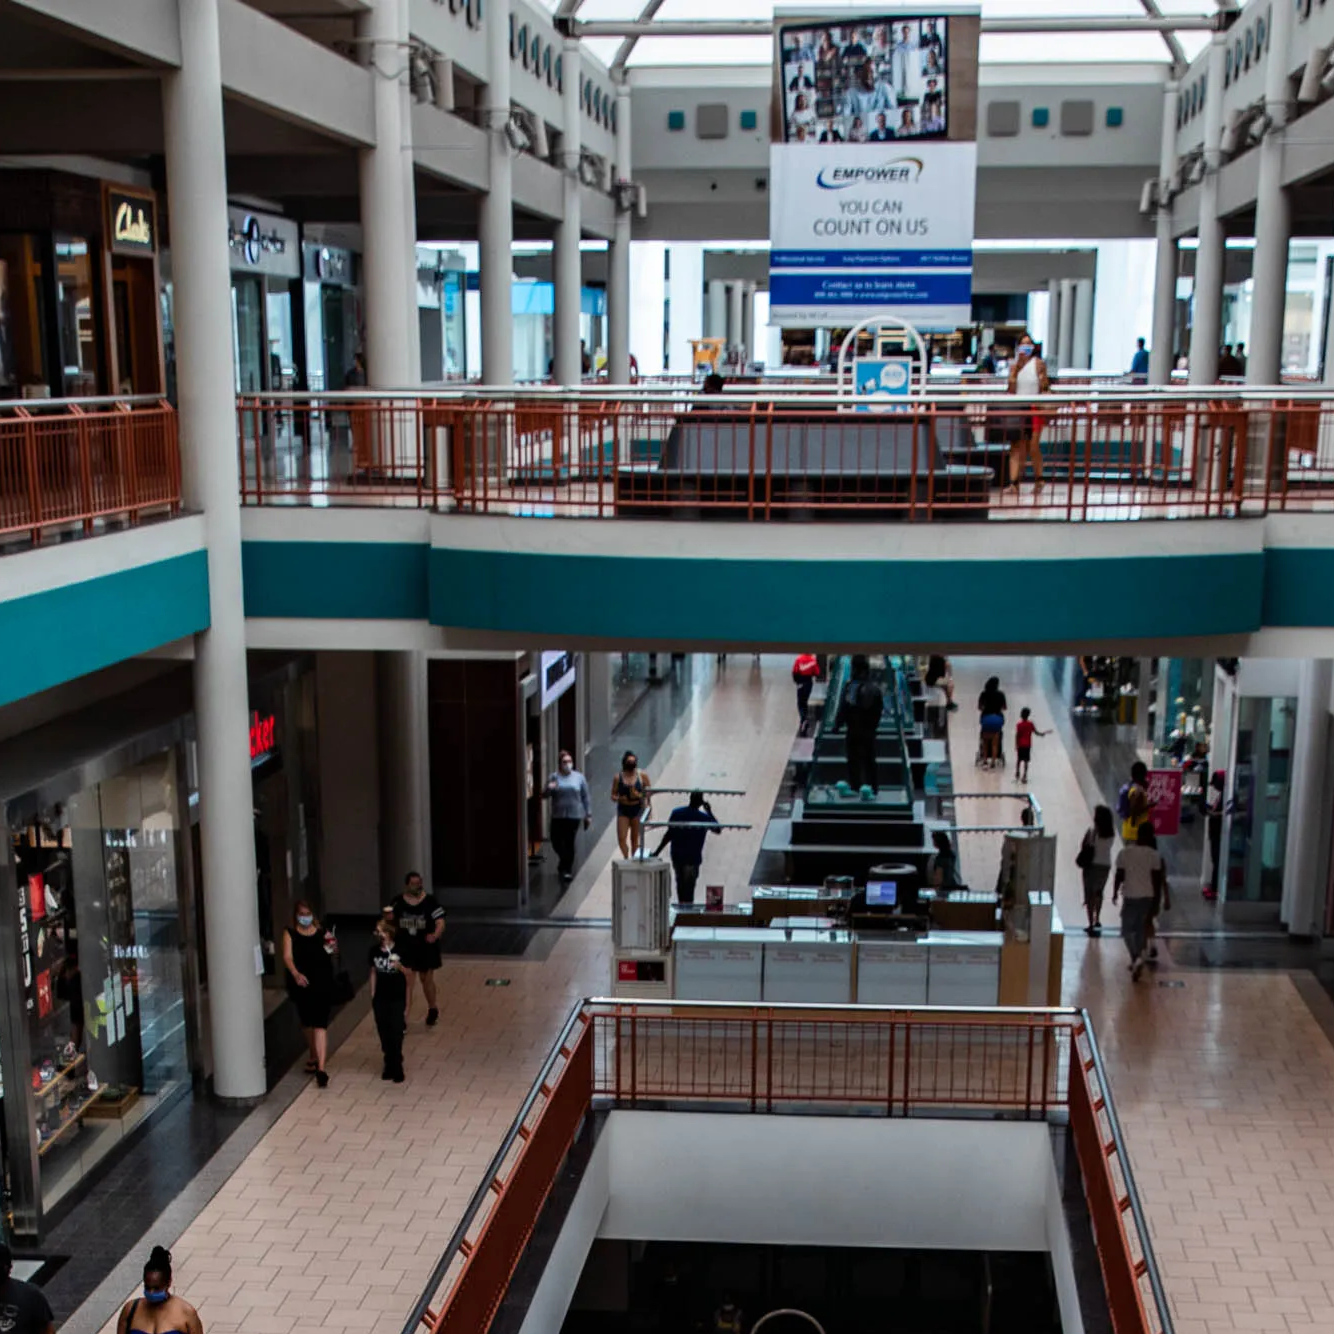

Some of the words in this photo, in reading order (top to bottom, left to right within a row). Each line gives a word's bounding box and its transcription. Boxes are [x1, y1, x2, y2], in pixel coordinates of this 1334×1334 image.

[832, 166, 910, 182] EMPOWER
[839, 200, 869, 214] YOU
[872, 200, 903, 214] CAN
[813, 218, 872, 236] COUNT
[876, 218, 902, 236] ON
[906, 218, 929, 236] US
